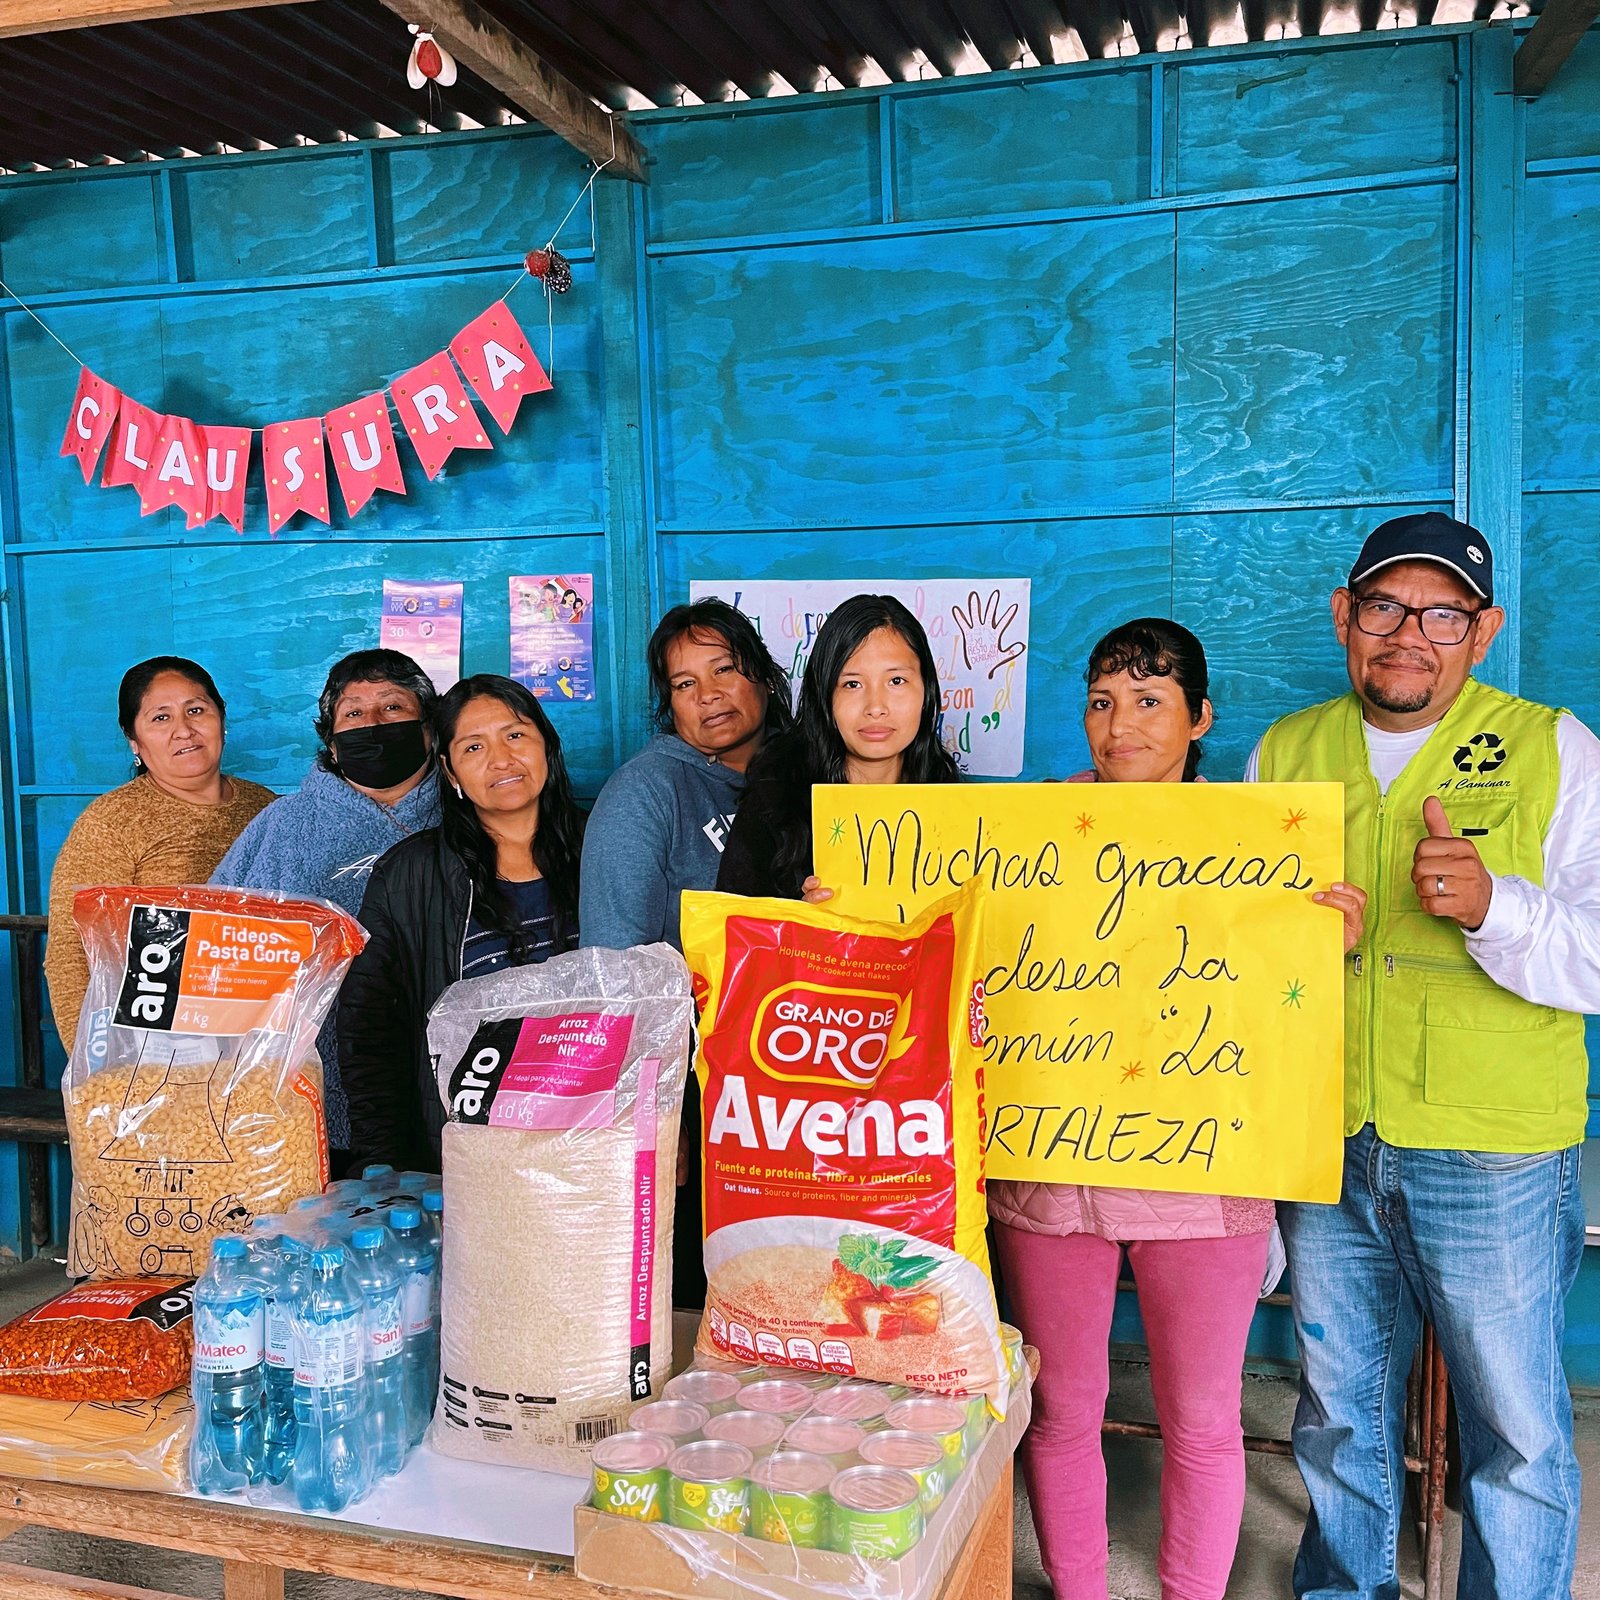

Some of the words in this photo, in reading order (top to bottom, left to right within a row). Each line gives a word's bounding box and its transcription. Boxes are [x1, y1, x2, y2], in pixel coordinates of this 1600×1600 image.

[76, 339, 526, 493] CLAUSURA
[1437, 778, 1453, 790] A
[1455, 778, 1512, 790] Caminar
[854, 809, 1064, 893] Muchas
[1096, 842, 1315, 941] gracias
[222, 925, 279, 945] Fideos
[197, 940, 250, 961] Pasta
[253, 945, 300, 964] Corta
[778, 945, 821, 962] Hojuelas
[824, 954, 837, 965] de
[840, 959, 871, 970] avena
[983, 923, 1121, 992] desea
[131, 943, 171, 1021] aro
[807, 962, 851, 977] Pre-cooked
[853, 970, 865, 979] oat
[867, 971, 891, 981] flakes
[180, 1010, 190, 1024] 4
[193, 1011, 209, 1028] kg
[558, 1018, 589, 1029] Arroz
[775, 1000, 864, 1028] GRANO
[868, 1006, 896, 1030] DE
[538, 1033, 607, 1048] Despuntado
[983, 1016, 1116, 1065] omún
[767, 1024, 889, 1085] ORO
[454, 1047, 500, 1116] aro
[496, 1104, 514, 1119] 10
[517, 1104, 533, 1126] kg
[708, 1074, 946, 1158] Avena
[640, 1174, 651, 1195] Nir
[715, 1160, 746, 1175] Fuente
[749, 1164, 761, 1176] de
[826, 1171, 855, 1183] fibra
[859, 1175, 867, 1185] y
[871, 1172, 932, 1184] minerales
[724, 1182, 736, 1192] Oat
[738, 1184, 762, 1195] flakes.
[764, 1188, 790, 1198] Source
[840, 1193, 860, 1201] fiber
[862, 1193, 878, 1202] and
[880, 1193, 917, 1202] minerals
[637, 1198, 653, 1282] Despuntado
[635, 1285, 647, 1321] Arroz
[757, 1316, 767, 1324] de
[768, 1317, 780, 1325] 40
[373, 1329, 398, 1346] San
[201, 1344, 246, 1358] Mateo
[906, 1373, 935, 1382] PESO
[939, 1368, 968, 1381] NETO
[610, 1479, 658, 1516] Soy
